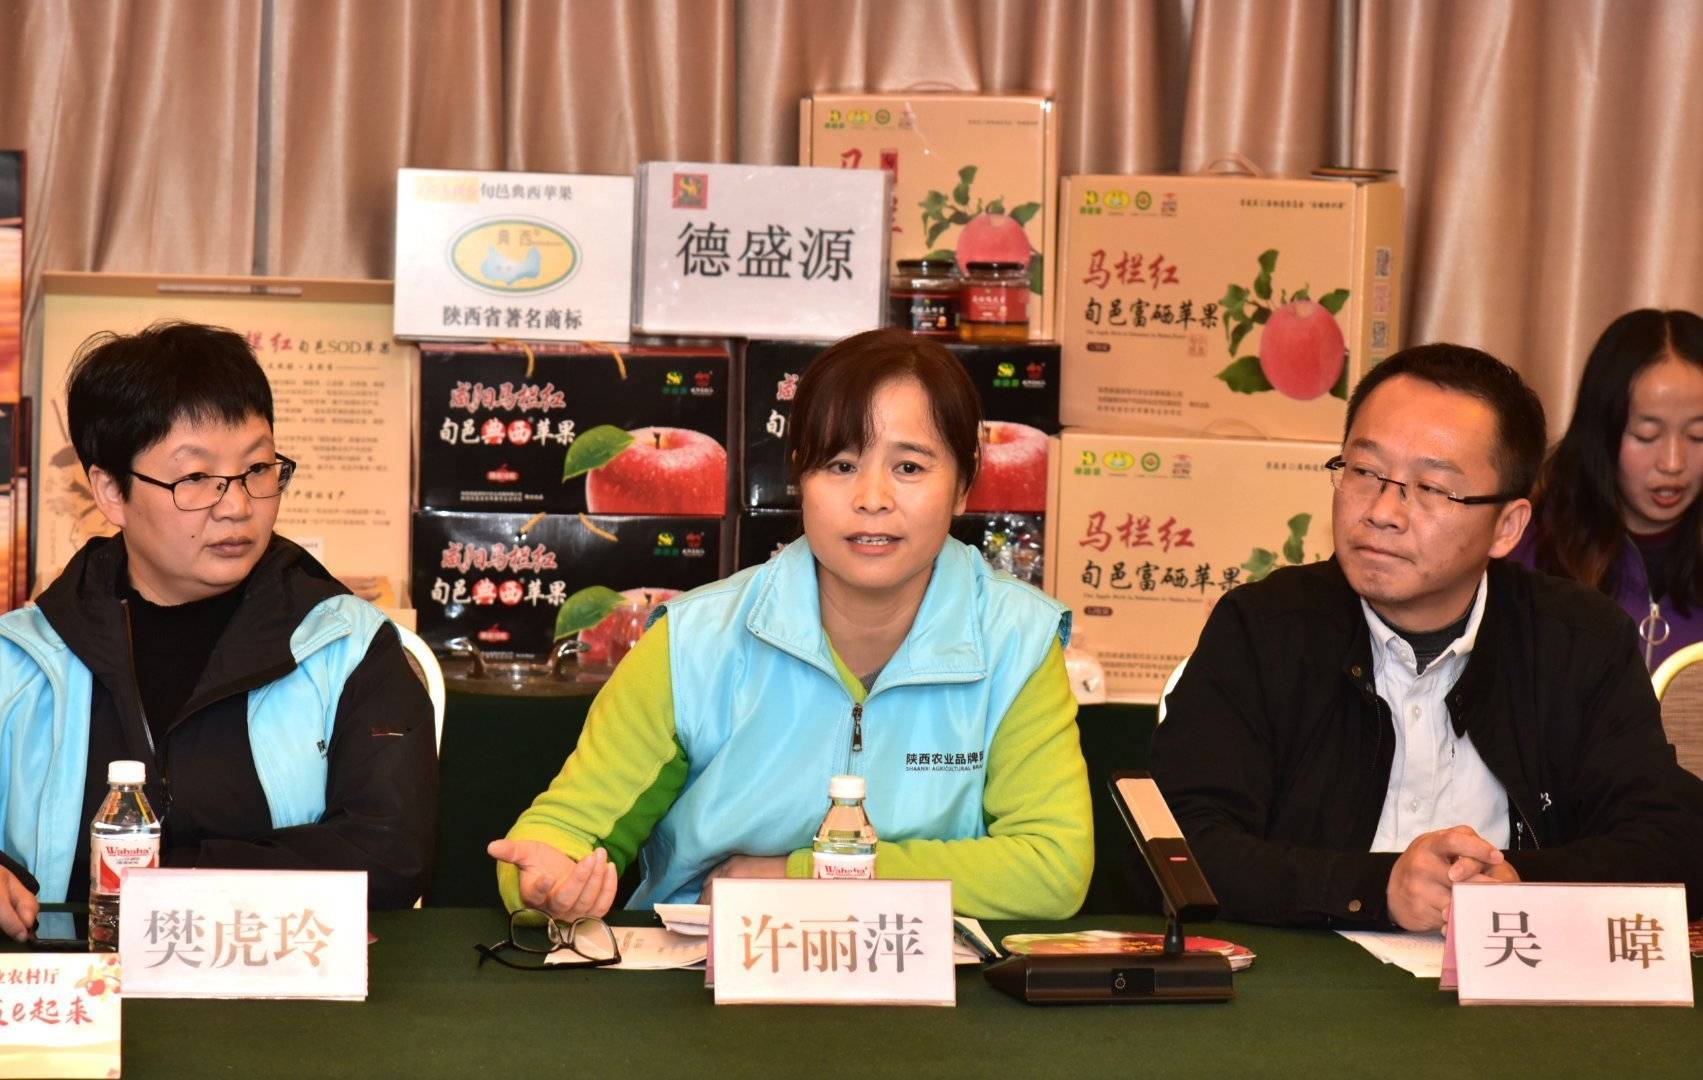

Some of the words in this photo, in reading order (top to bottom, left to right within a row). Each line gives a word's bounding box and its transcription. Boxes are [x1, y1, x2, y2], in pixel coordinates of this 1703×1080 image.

[675, 221, 856, 281] 德盛源
[1083, 249, 1180, 290] 马栏红
[442, 304, 583, 330] 陕西省著名商标
[1084, 297, 1219, 330] 旬邑富硒苹果
[1079, 511, 1195, 552] 马栏红
[106, 845, 149, 856] Wahaha
[143, 908, 335, 969] 樊虎玲
[739, 914, 924, 974] 许丽萍
[1484, 911, 1542, 969] 吴
[0, 995, 93, 1026] e起来
